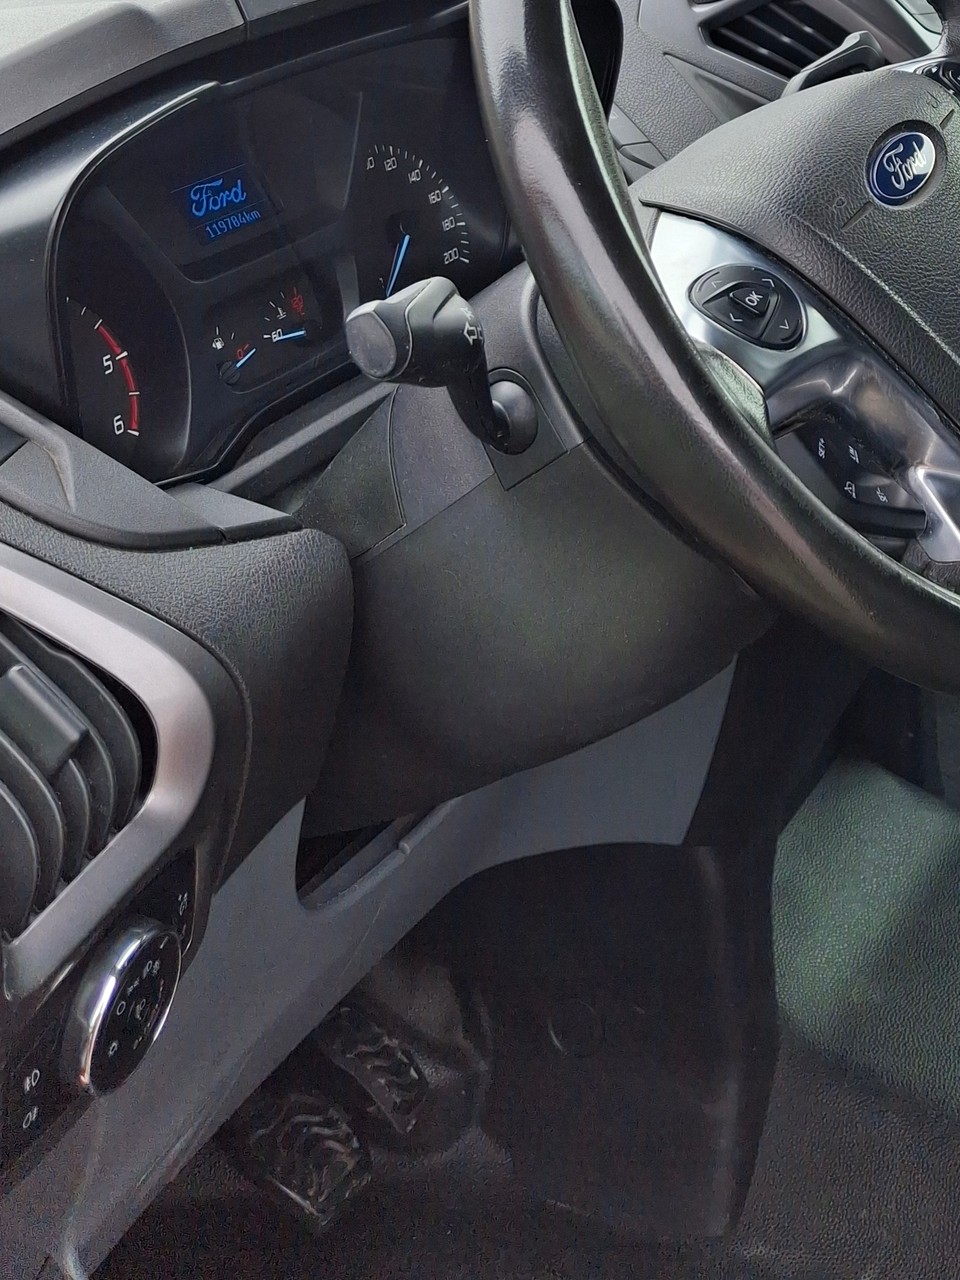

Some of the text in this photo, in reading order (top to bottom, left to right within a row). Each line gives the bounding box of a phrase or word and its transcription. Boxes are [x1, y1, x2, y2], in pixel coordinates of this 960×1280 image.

[384, 157, 398, 172] 120
[882, 141, 927, 190] Ford
[408, 169, 422, 184] 140
[190, 178, 247, 217] Ford
[428, 190, 443, 204] 160
[442, 217, 456, 232] 180
[443, 247, 460, 265] 200
[745, 290, 764, 306] OK
[102, 354, 114, 375] 5
[113, 414, 124, 435] 6
